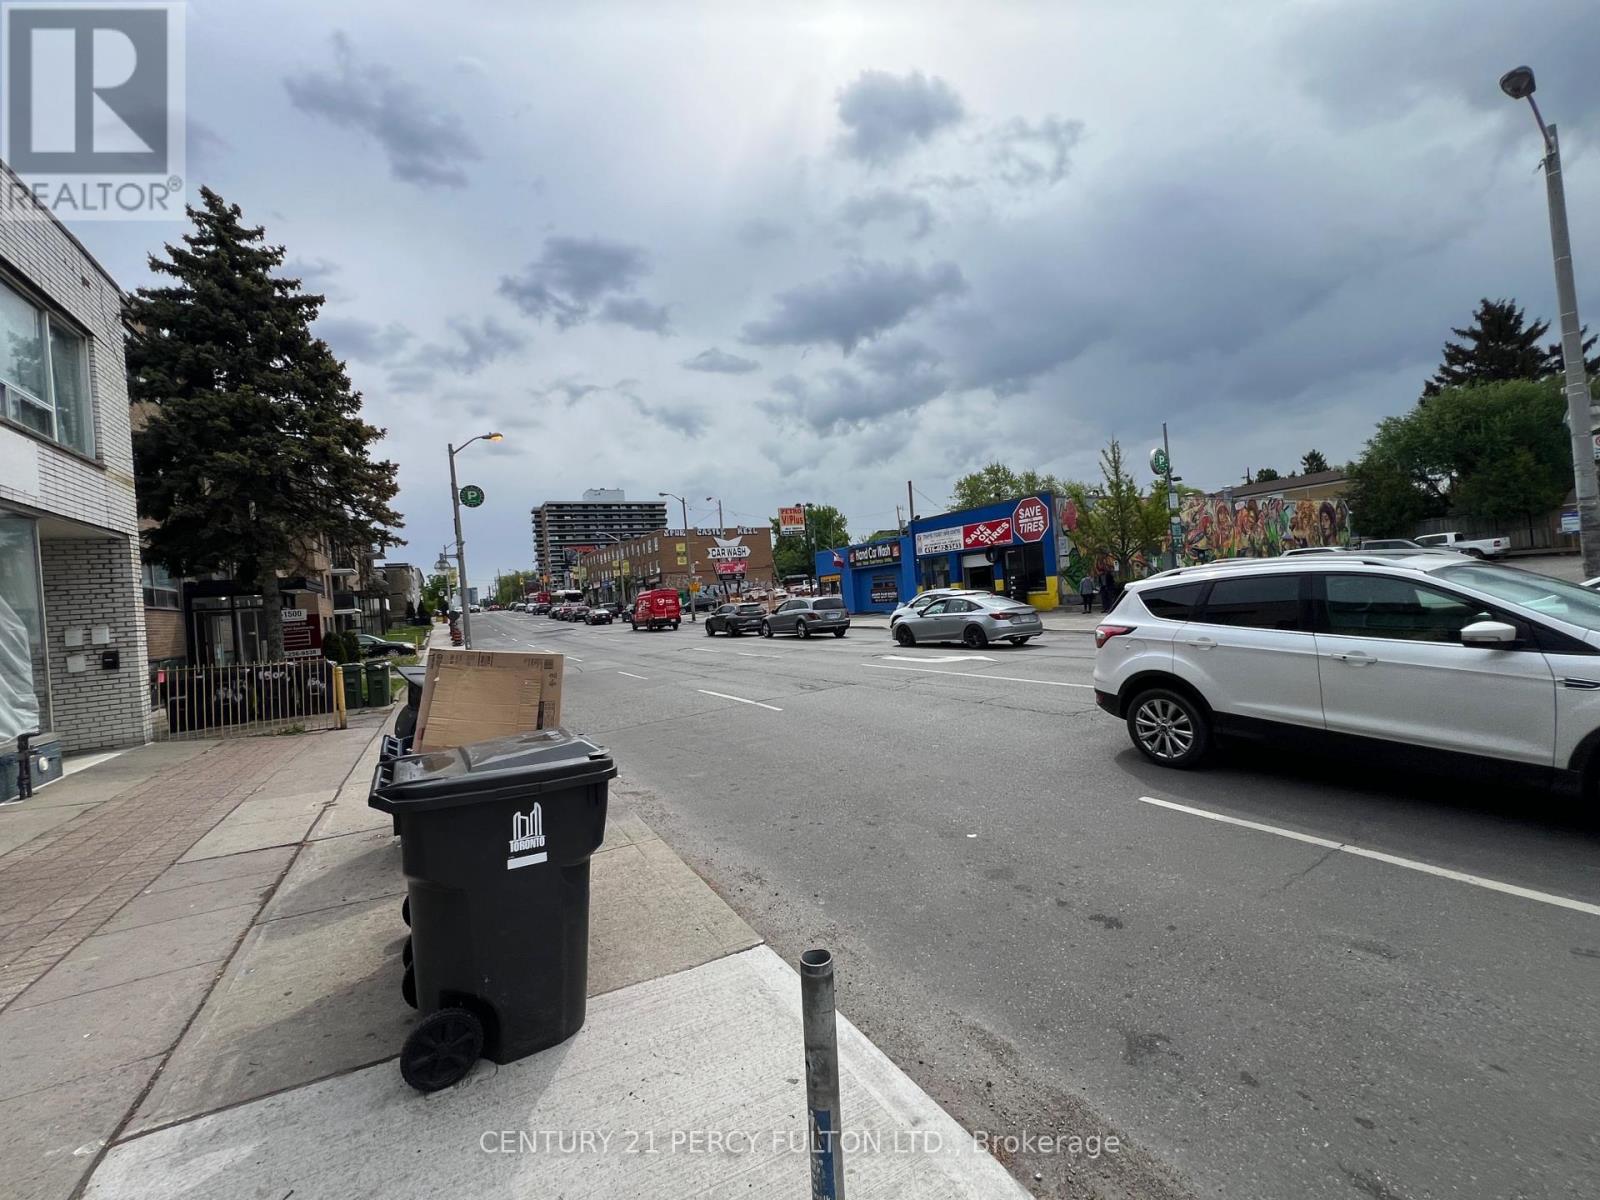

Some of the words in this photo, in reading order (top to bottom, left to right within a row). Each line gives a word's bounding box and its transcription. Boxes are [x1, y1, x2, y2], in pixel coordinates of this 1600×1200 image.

[467, 490, 478, 500] P
[1018, 504, 1042, 520] SAVE
[965, 524, 987, 545] SAVE
[984, 521, 1010, 545] TIRES
[1019, 520, 1046, 534] TIRES
[978, 528, 992, 542] ON
[711, 548, 726, 558] CAR
[727, 547, 747, 557] WASH
[868, 546, 877, 559] Car
[877, 544, 891, 558] Wash
[509, 835, 546, 853] TORONTO
